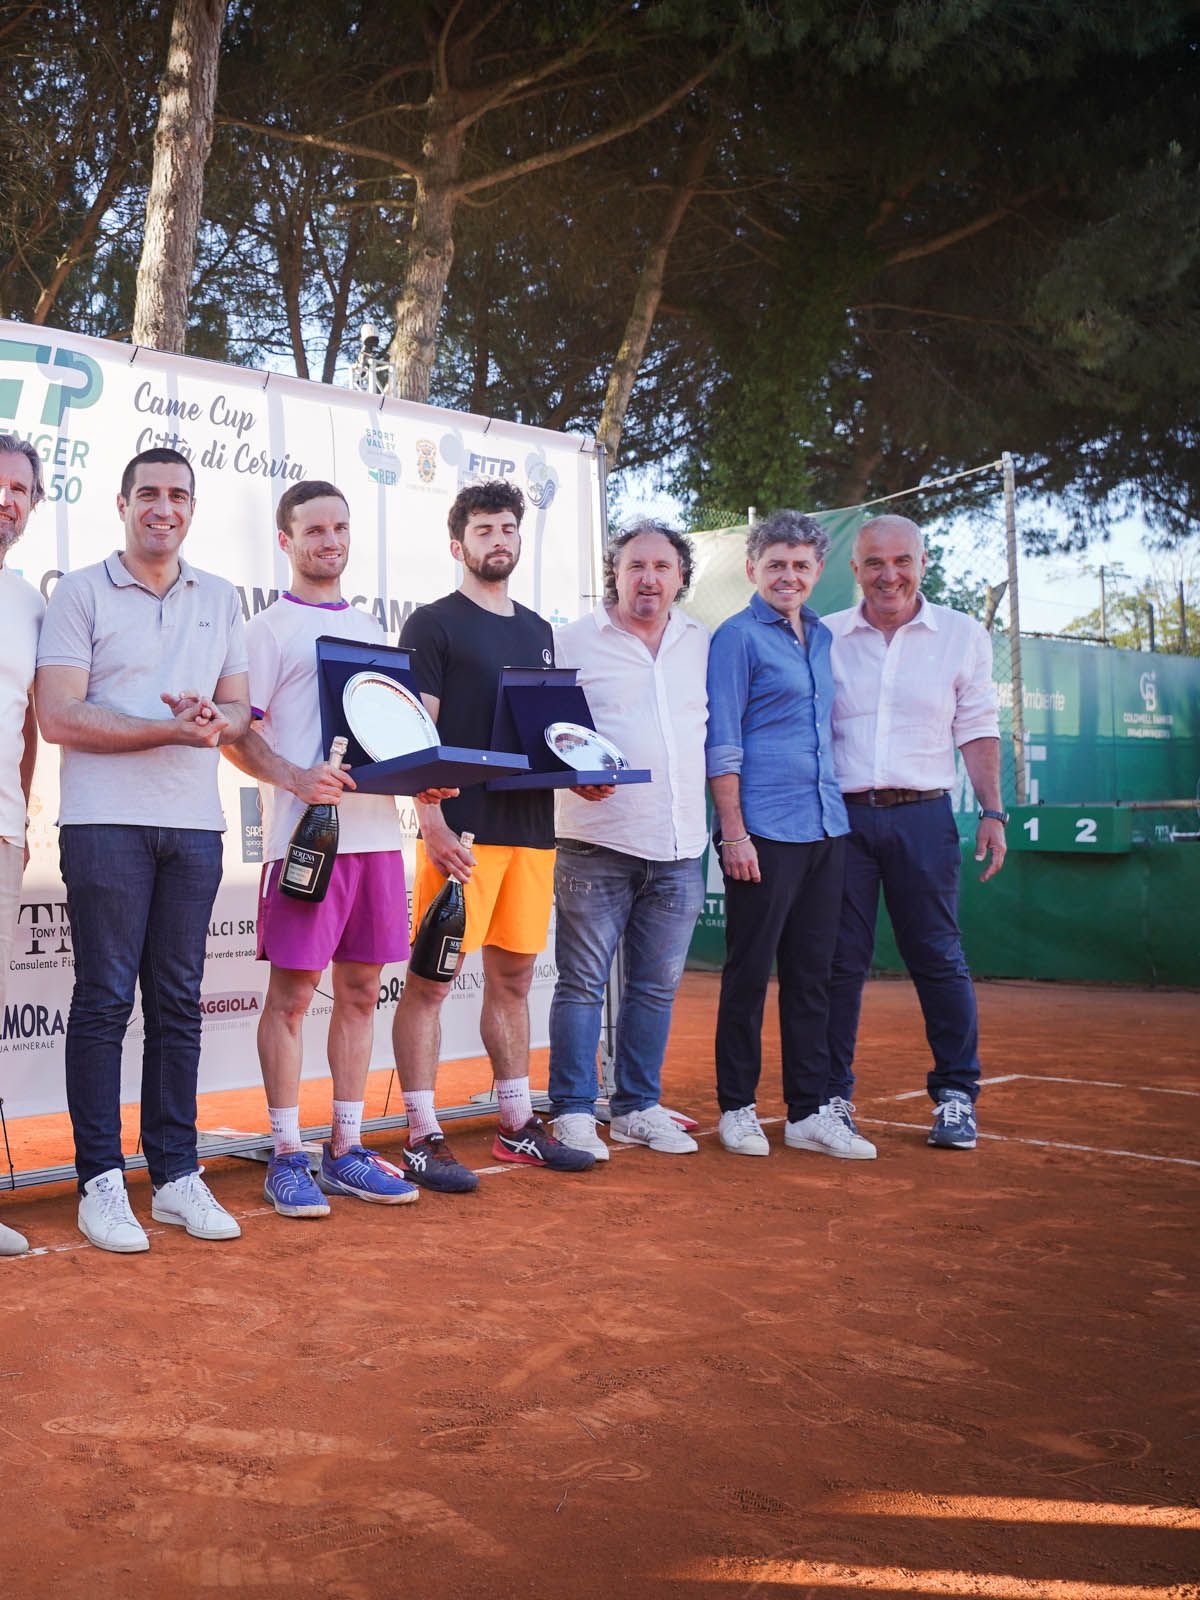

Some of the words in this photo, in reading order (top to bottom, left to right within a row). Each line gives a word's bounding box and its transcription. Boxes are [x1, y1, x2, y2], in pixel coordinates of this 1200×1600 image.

[134, 381, 202, 421] Came
[209, 395, 256, 439] Cup
[201, 439, 228, 470] di
[234, 443, 306, 481] Cervia
[469, 453, 516, 477] FITP
[351, 595, 426, 633] CAM
[1021, 686, 1065, 711] mbiente
[1023, 817, 1039, 842] 1
[1074, 818, 1098, 843] 2
[9, 959, 58, 971] Consulente
[214, 949, 234, 959] verde
[0, 1003, 65, 1040] MORA
[11, 1040, 55, 1052] MINERALE
